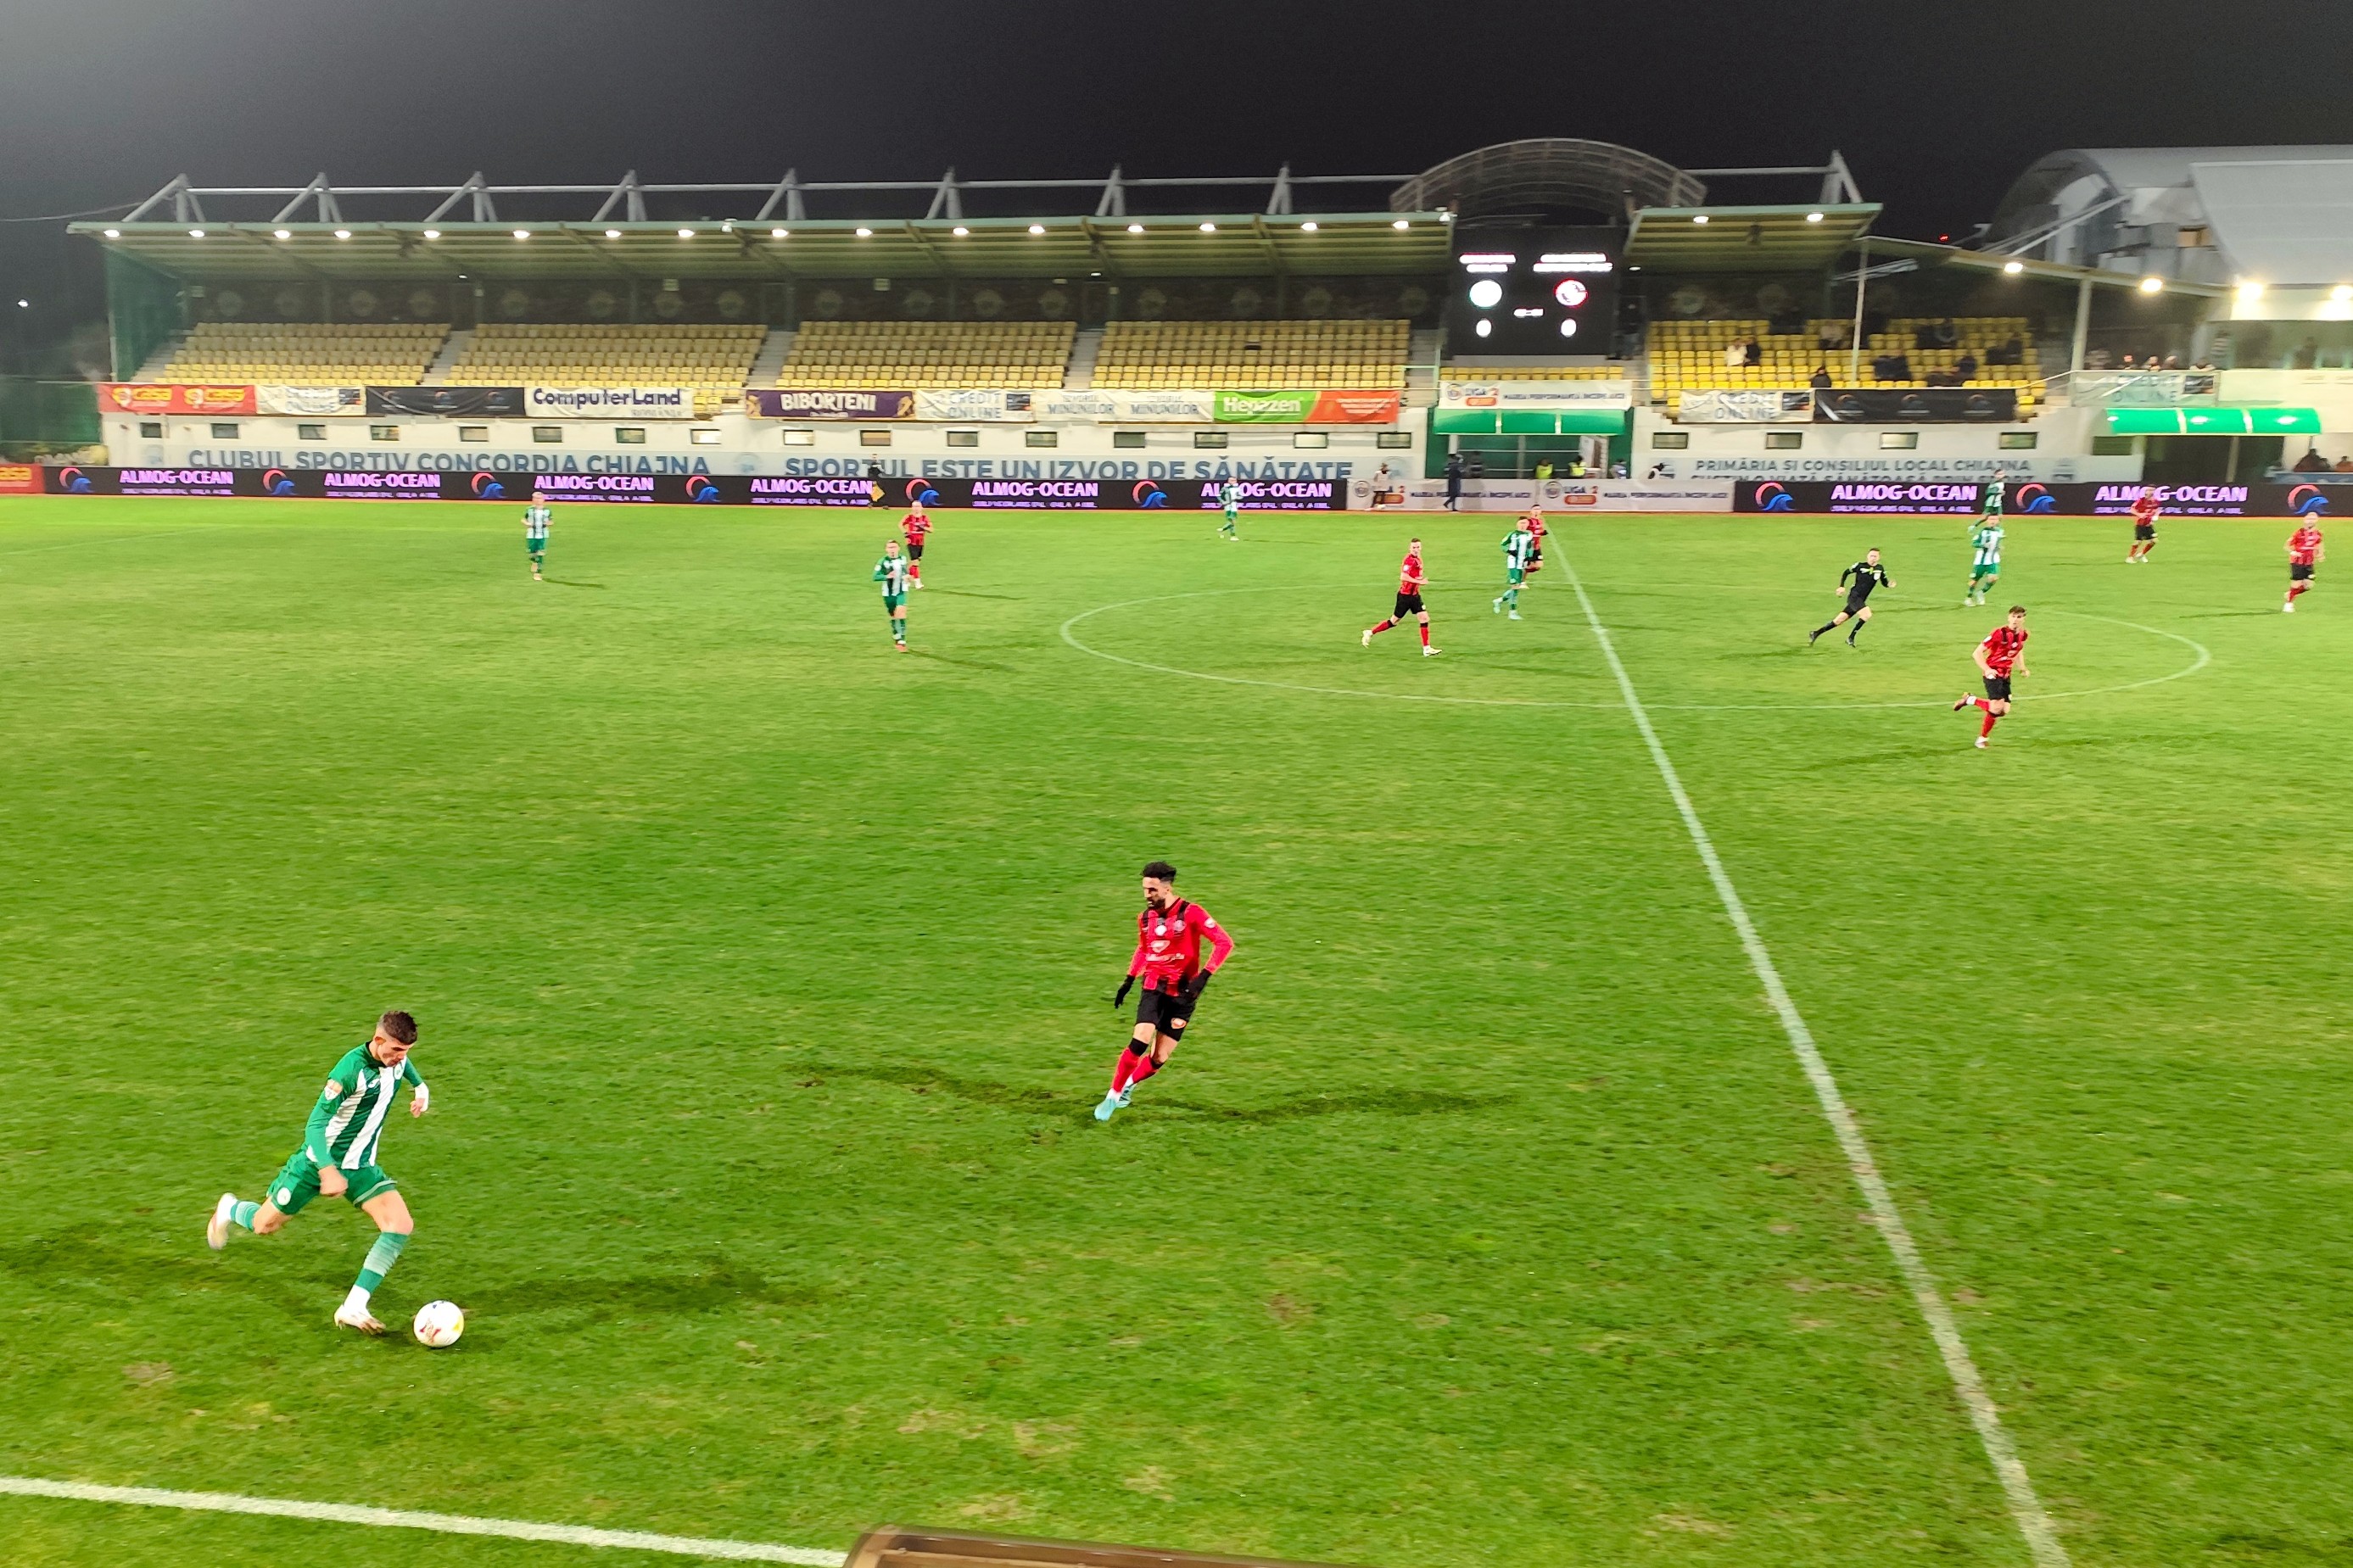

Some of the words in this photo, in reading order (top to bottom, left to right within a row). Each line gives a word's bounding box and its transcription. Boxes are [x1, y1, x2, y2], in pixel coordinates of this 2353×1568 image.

[534, 388, 681, 409] ComputerLand
[780, 392, 877, 411] BIBORTENI
[189, 449, 289, 469] CLUBUL
[295, 451, 411, 470] SPORTIV
[417, 453, 578, 472] CONCORDIA
[586, 455, 711, 474] CHIAJNA
[922, 460, 993, 478] ESTE
[1001, 460, 1041, 479] UN
[1050, 460, 1140, 480] IZVOR
[1148, 461, 1186, 479] DE
[1194, 455, 1353, 480] SĂNĂTATE
[1894, 460, 1949, 472] LOCAL
[119, 470, 233, 484] ALMOG-OCEAN
[324, 472, 440, 488] ALMOG-OCEAN
[534, 475, 654, 490] ALMOG-OCEAN
[751, 478, 873, 494] ALMOG-OCEAN
[971, 482, 1098, 497] ALMOG-OCEAN
[1200, 483, 1332, 497] ALOG-OCEAN
[1830, 484, 1978, 500] ALMOG-OCEAN
